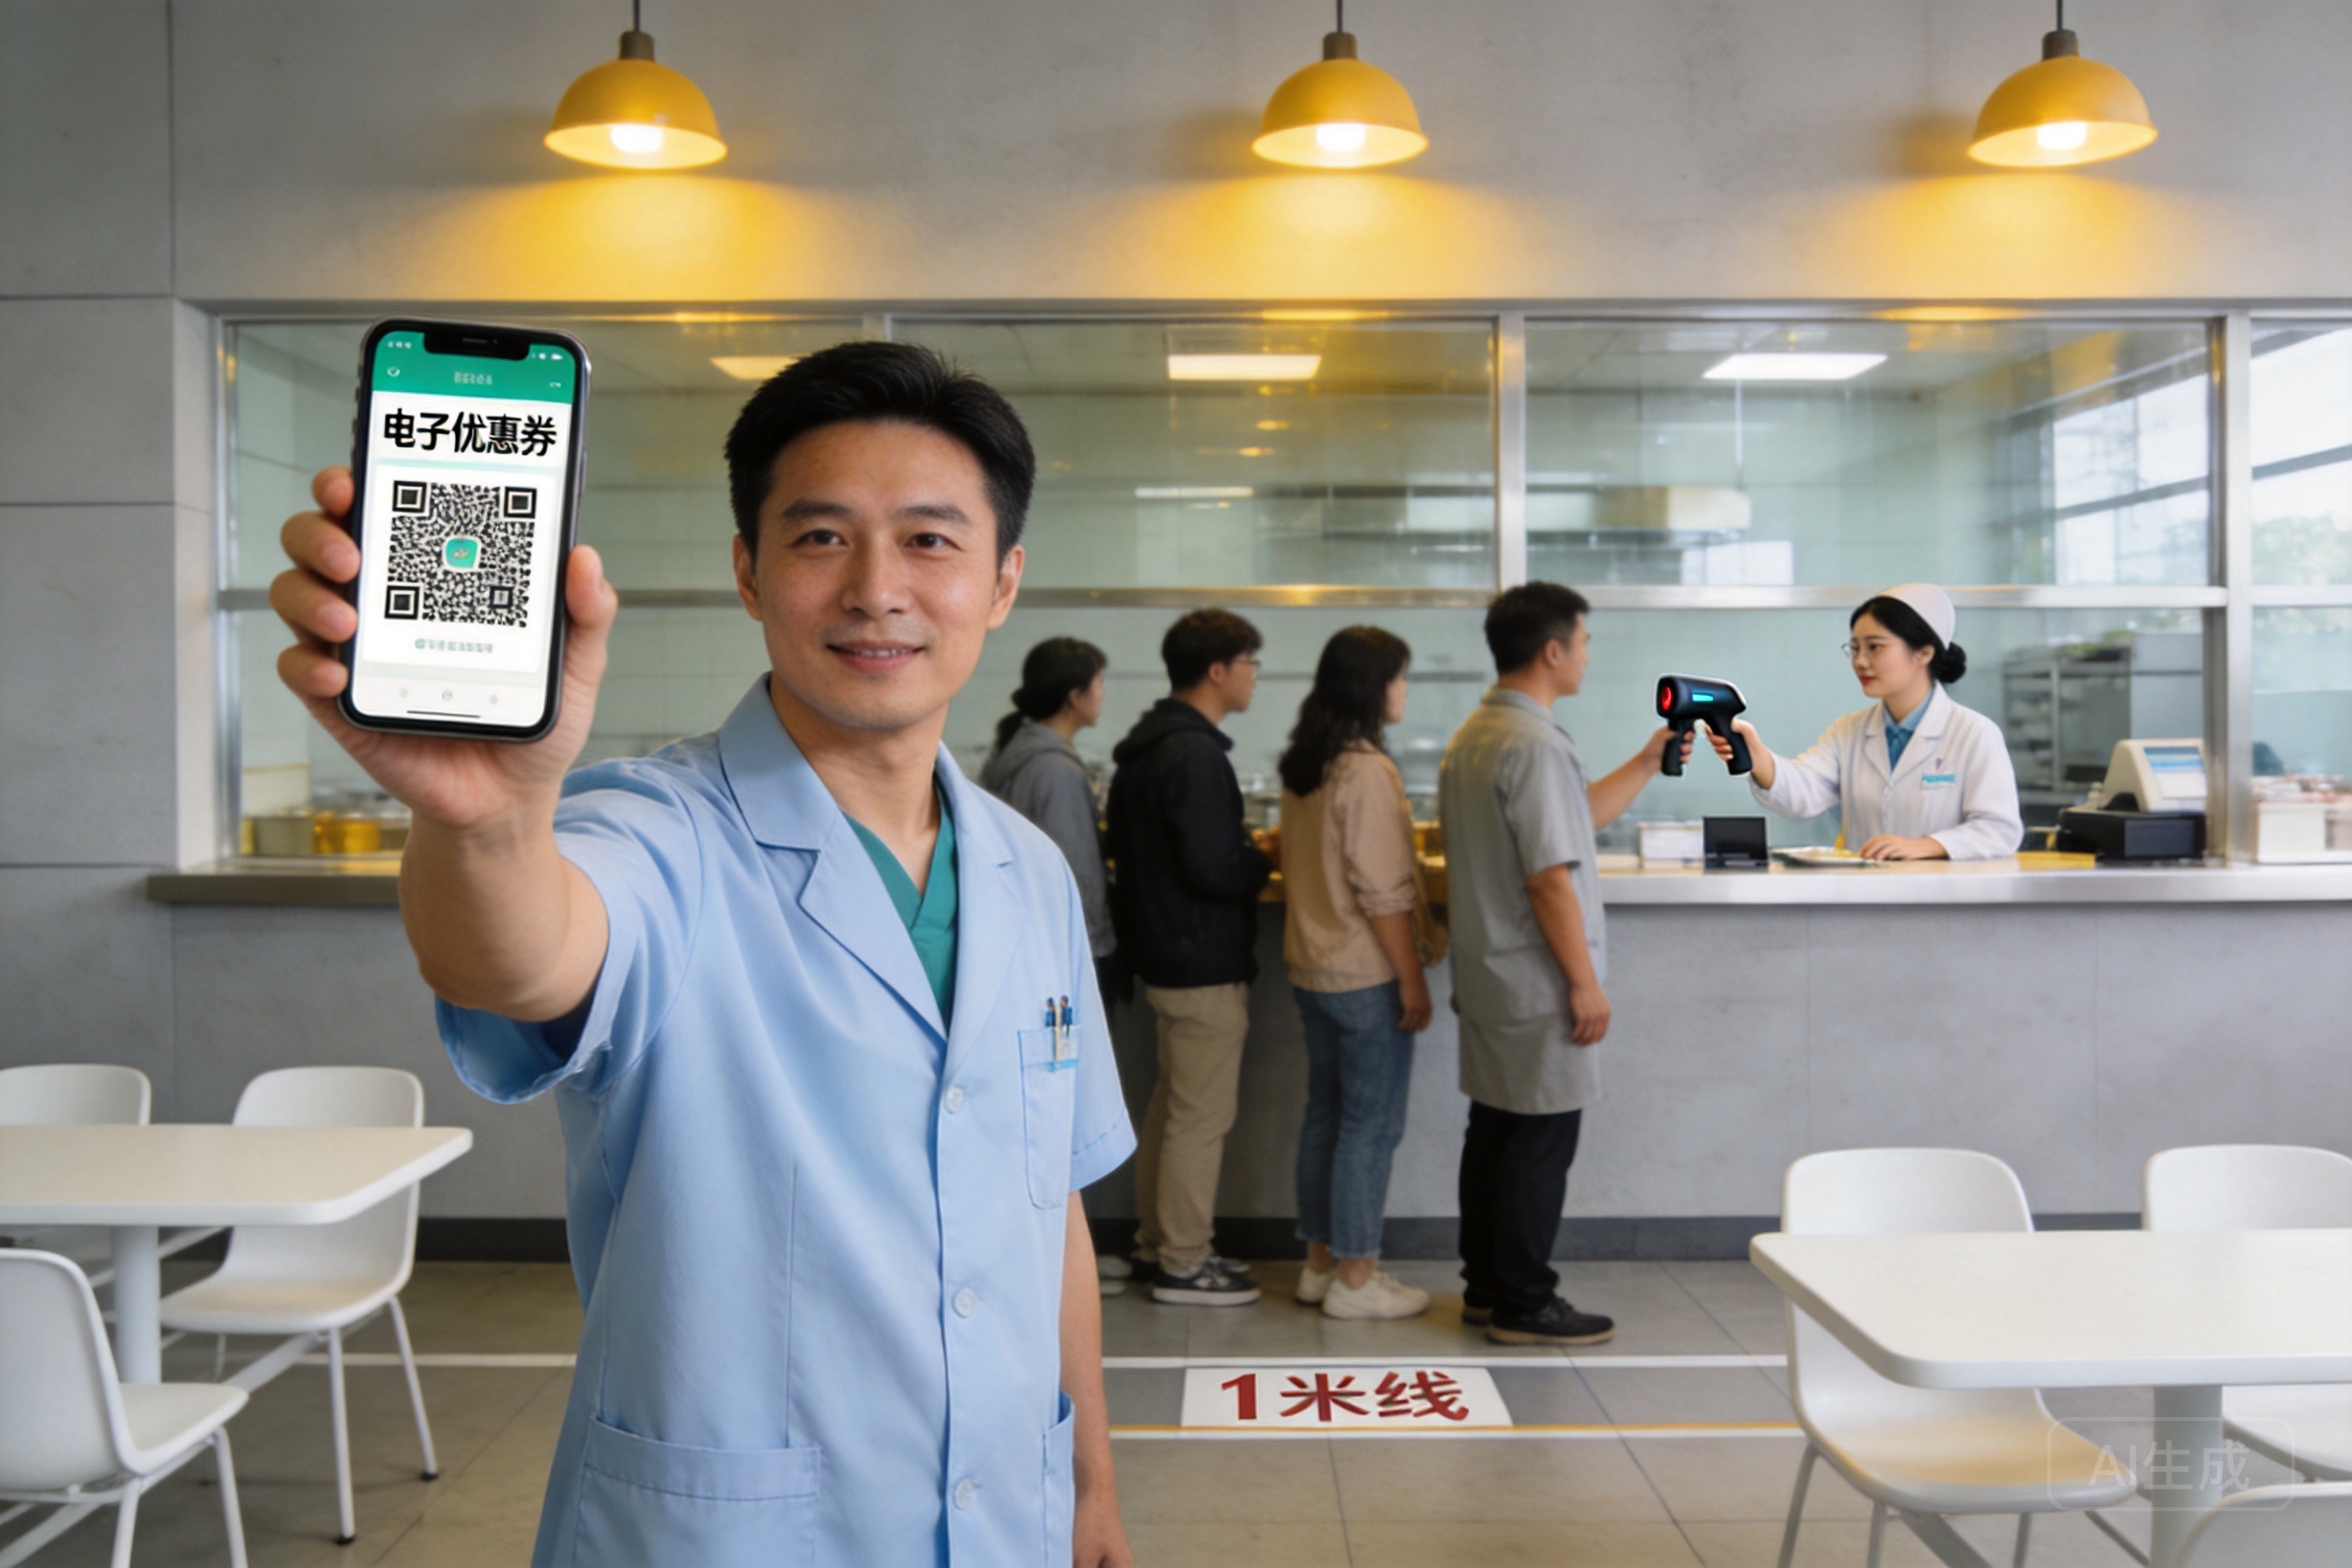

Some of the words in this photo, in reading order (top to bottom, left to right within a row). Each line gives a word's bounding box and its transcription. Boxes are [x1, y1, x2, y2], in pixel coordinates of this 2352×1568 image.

[383, 408, 557, 457] 电子优惠券
[1221, 1370, 1469, 1422] 1米线
